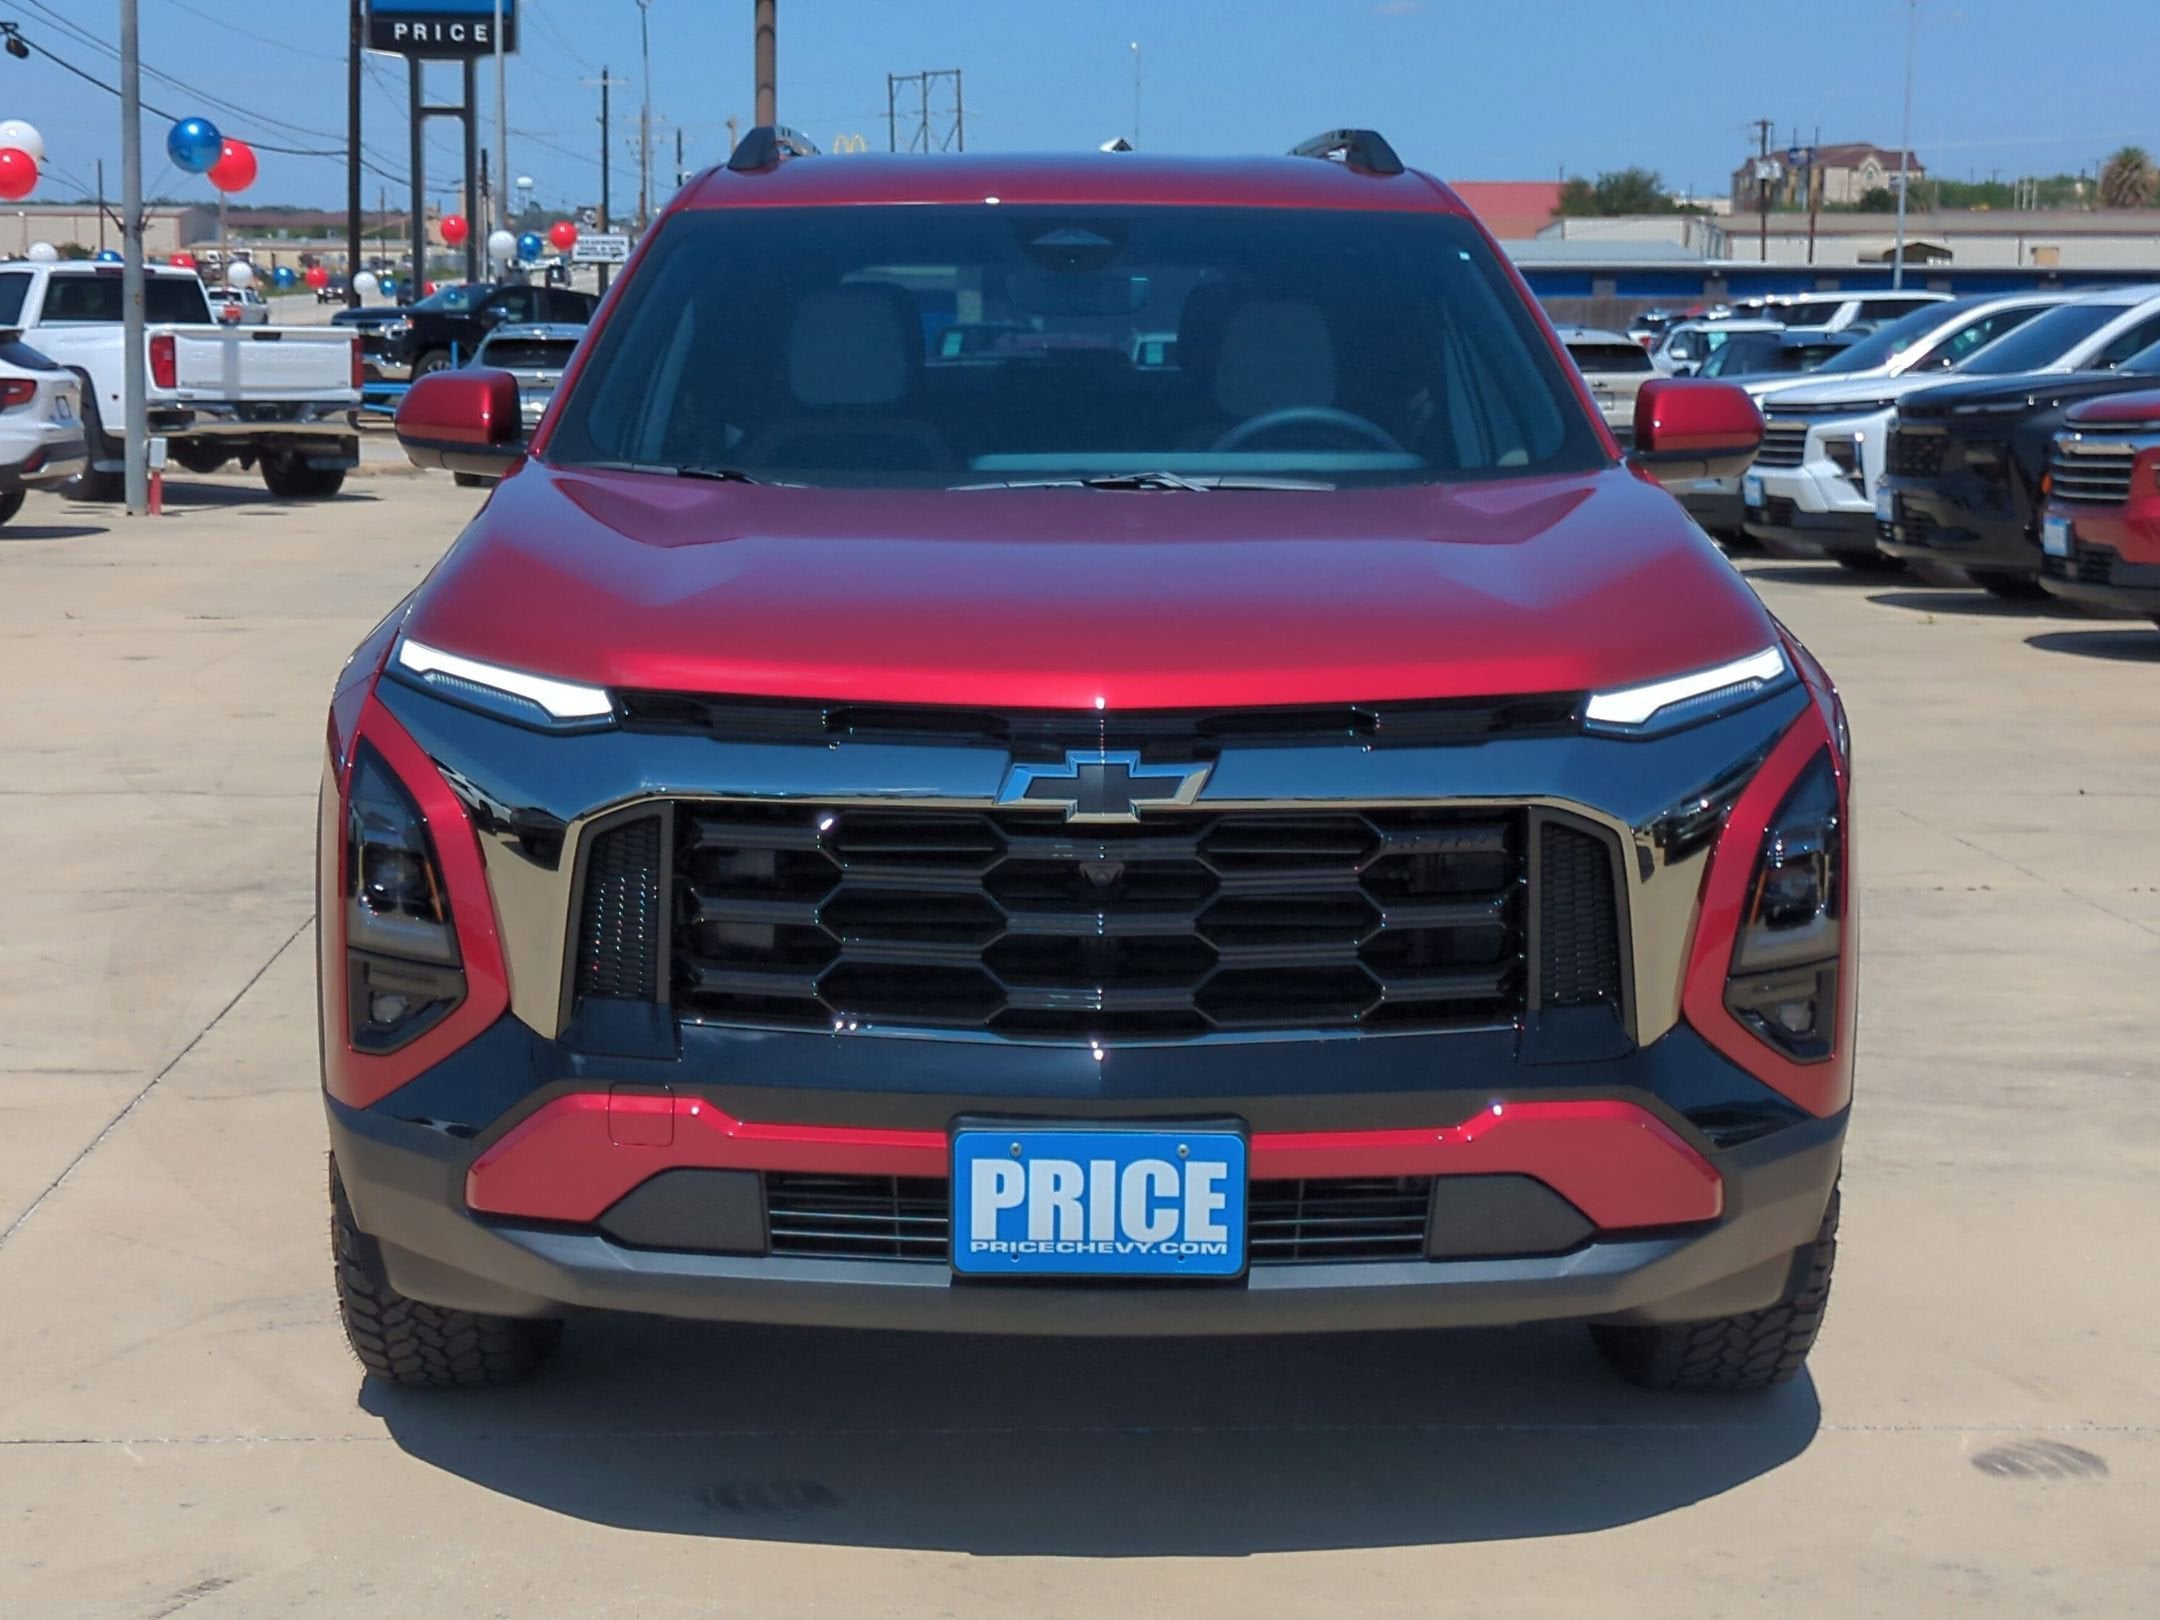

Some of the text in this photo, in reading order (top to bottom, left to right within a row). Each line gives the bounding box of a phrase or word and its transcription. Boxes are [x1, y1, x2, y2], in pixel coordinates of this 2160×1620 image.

[393, 22, 489, 42] PRICE
[970, 1158, 1228, 1243] PRICE
[970, 1240, 1228, 1255] PRICECHEVY.COM
